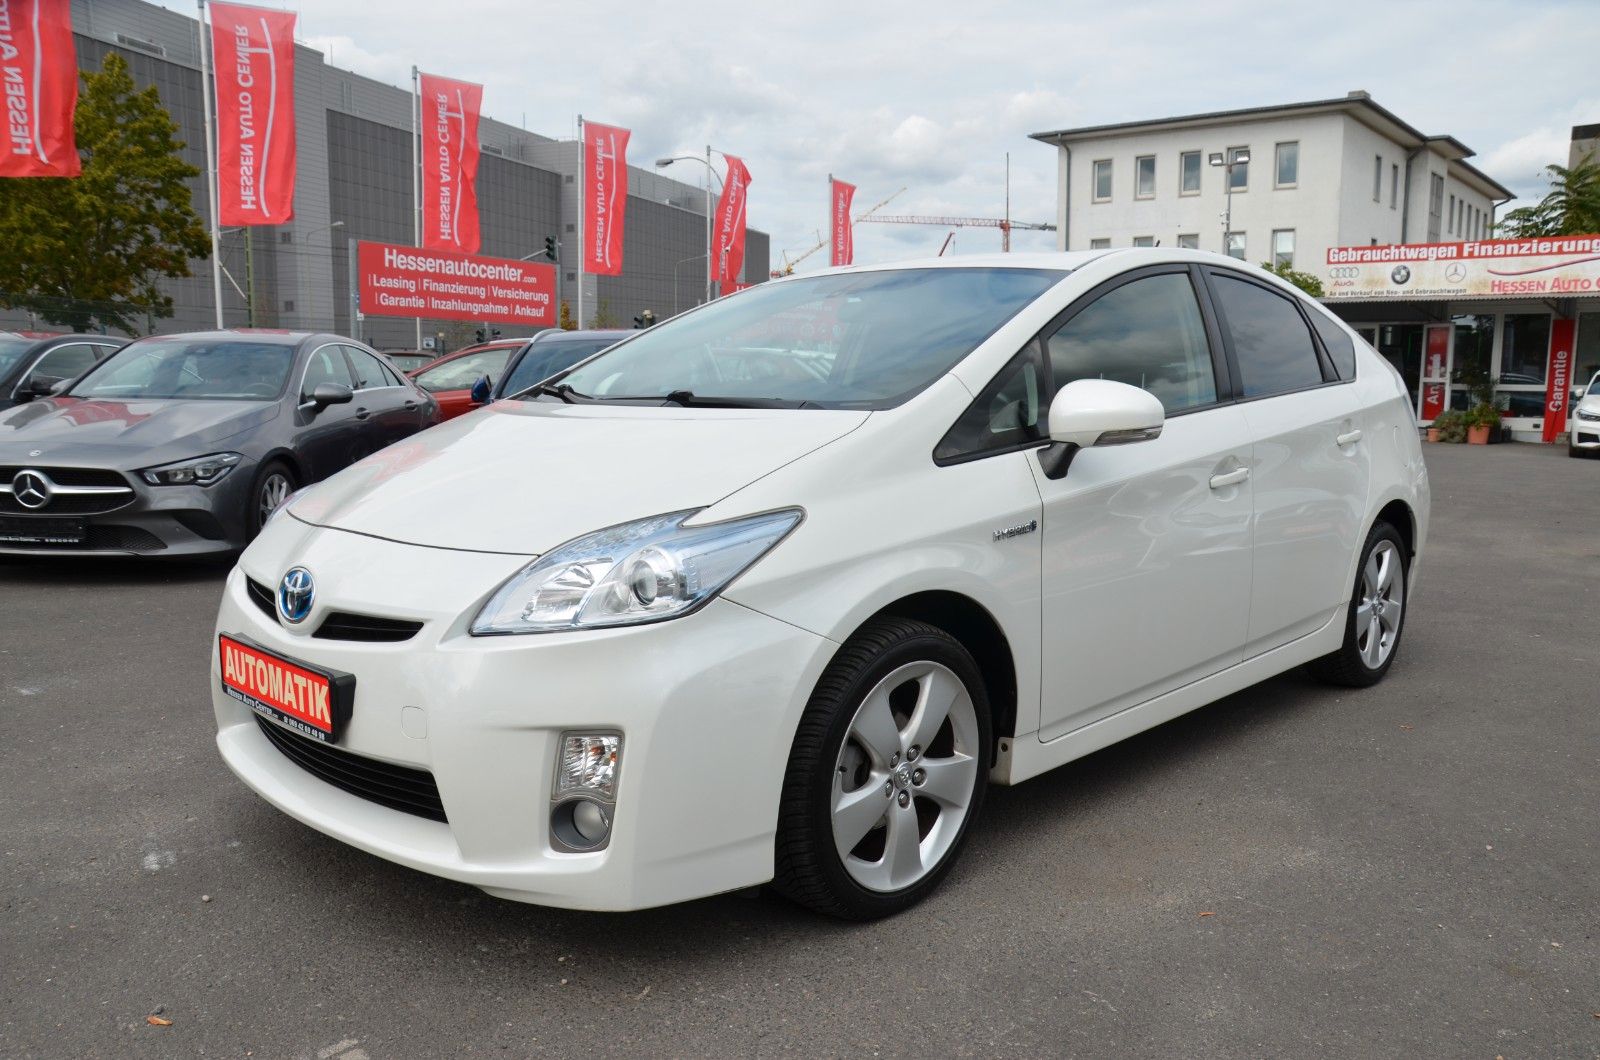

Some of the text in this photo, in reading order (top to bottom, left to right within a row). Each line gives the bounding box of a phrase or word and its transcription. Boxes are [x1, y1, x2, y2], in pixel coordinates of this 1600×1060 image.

[1329, 238, 1600, 262] Gebrauchtwagen Finanzierung
[373, 273, 549, 305] Leasing Finanzierung Versicherung
[1491, 280, 1546, 293] HESSEN
[1551, 278, 1592, 291] AUTO
[380, 293, 545, 317] Garantie Inzahlungnahme Ankauf
[1549, 351, 1568, 411] Garantie
[225, 646, 331, 724] AUTOMATIK
